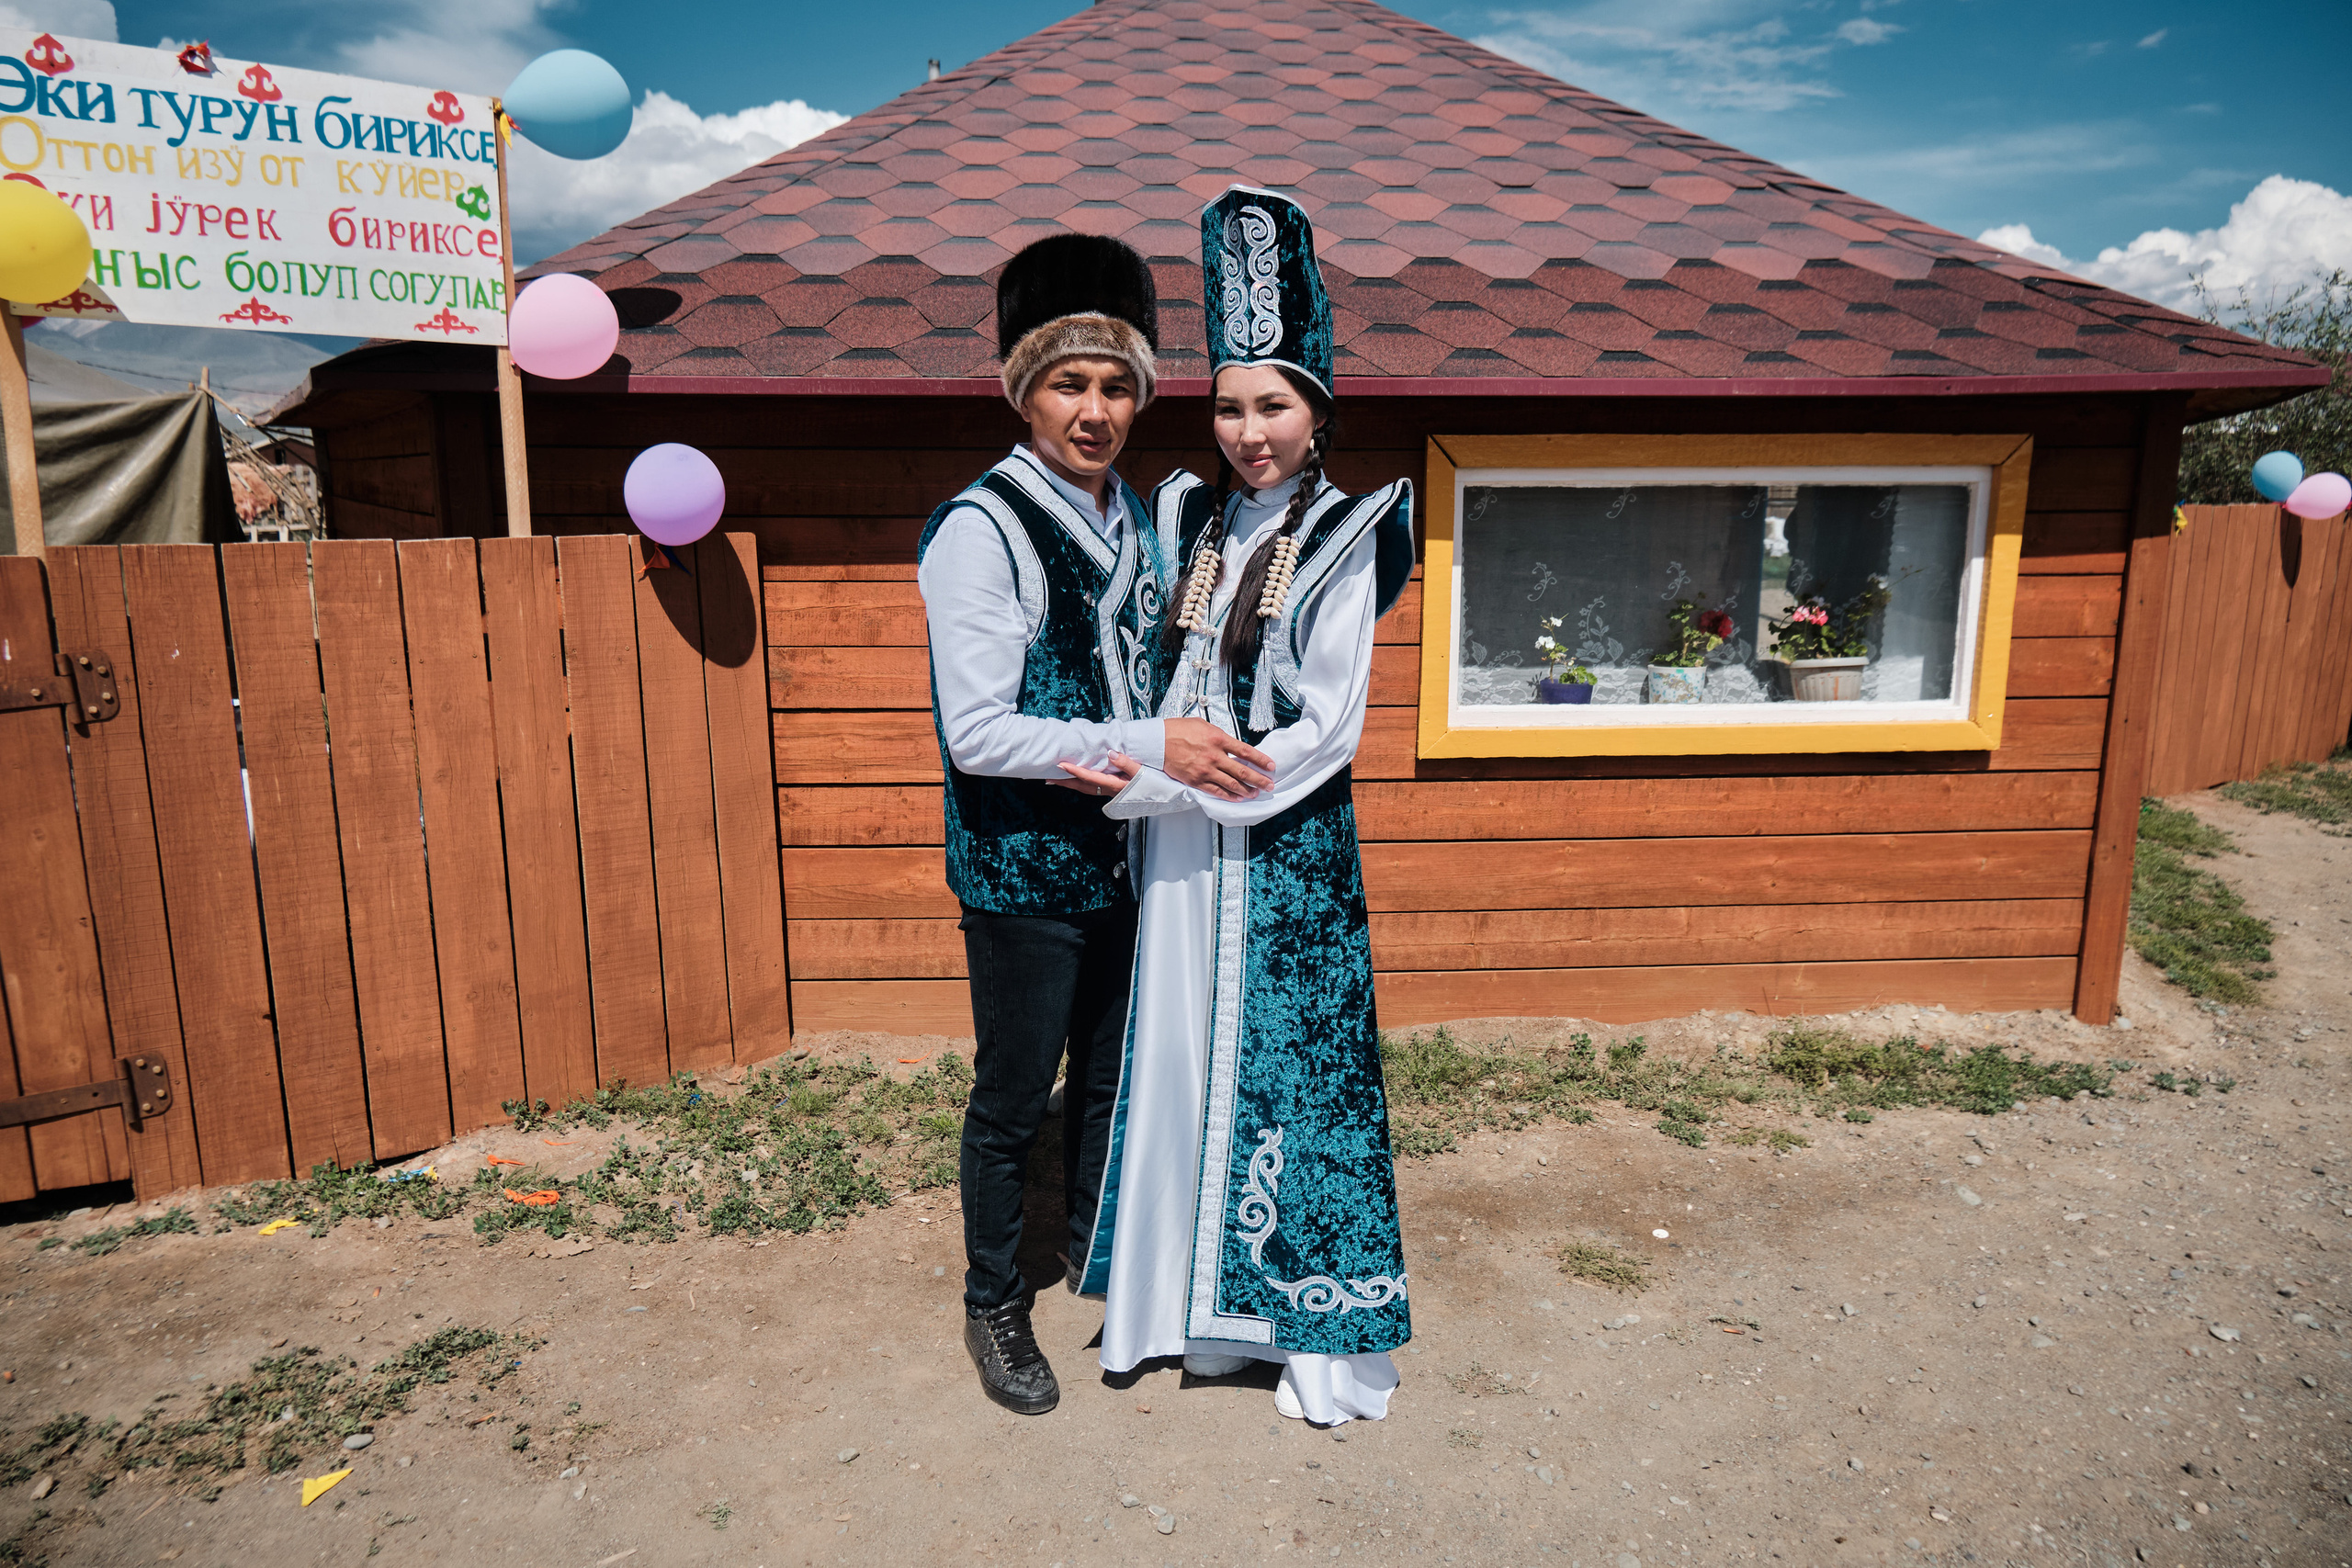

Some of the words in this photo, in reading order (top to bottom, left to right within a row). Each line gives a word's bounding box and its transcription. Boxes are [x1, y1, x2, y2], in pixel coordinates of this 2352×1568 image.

[0, 115, 156, 175] Оттон
[260, 153, 305, 188] от
[225, 250, 358, 300] болуп
